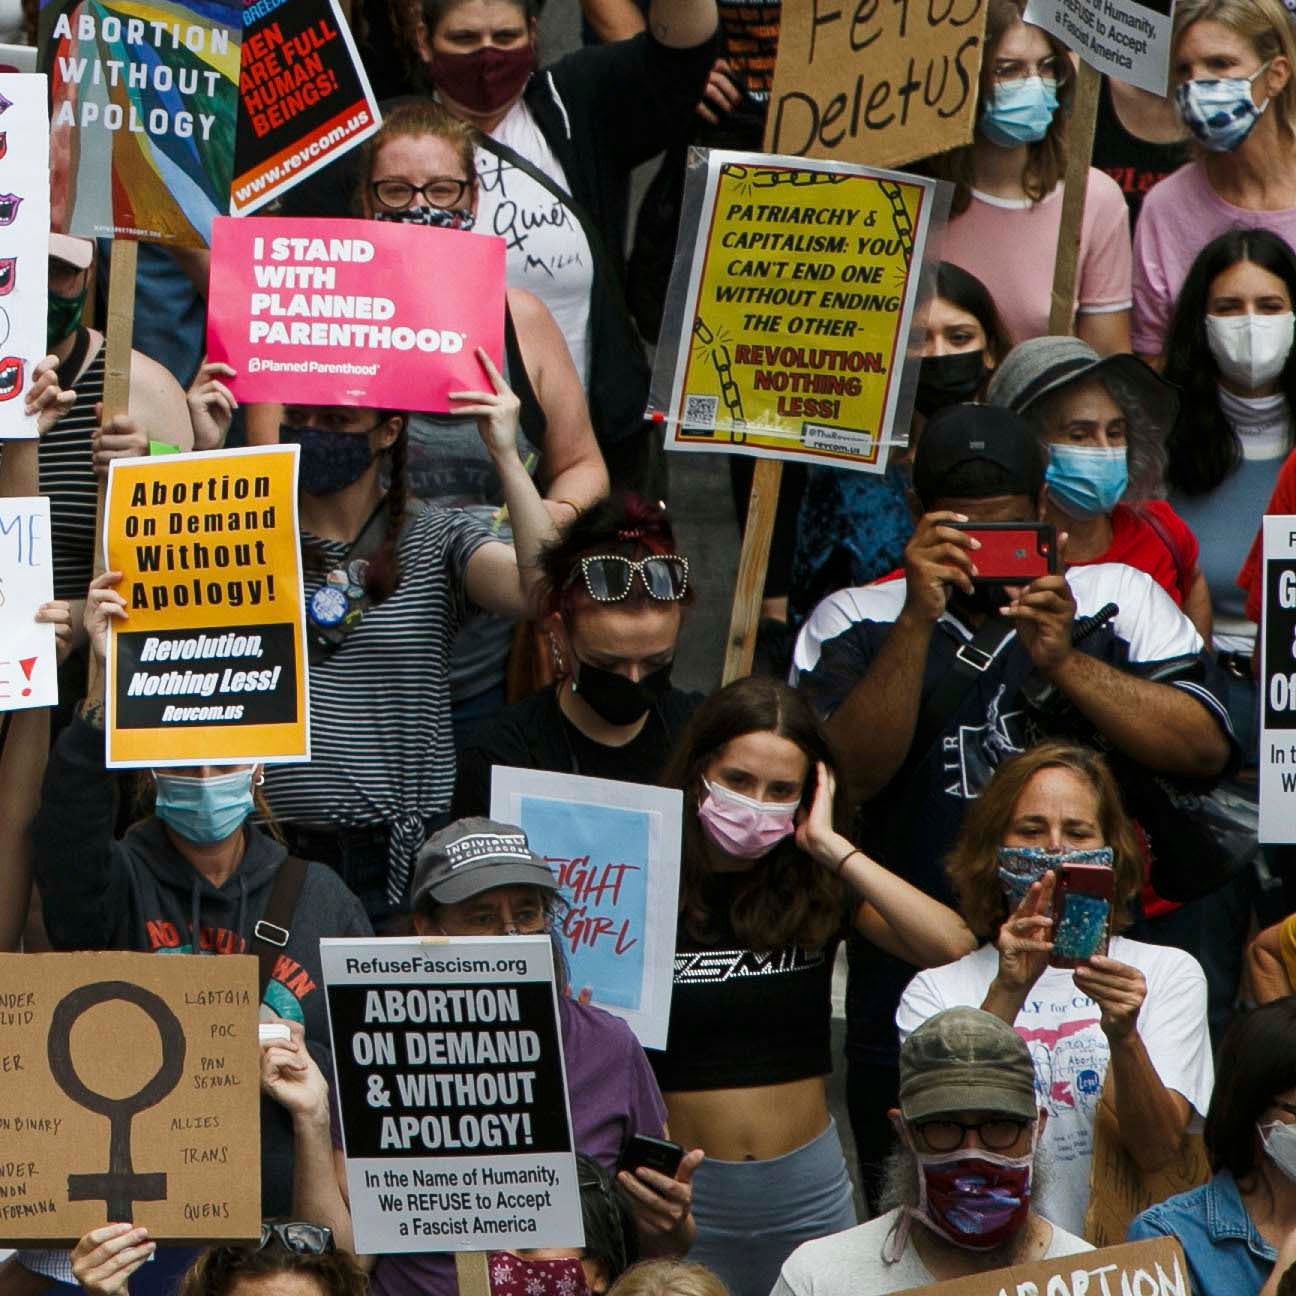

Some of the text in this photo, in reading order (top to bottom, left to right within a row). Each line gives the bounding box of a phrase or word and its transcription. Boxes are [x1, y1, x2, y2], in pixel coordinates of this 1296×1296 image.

[53, 12, 229, 55] ABORTION
[58, 56, 221, 97] WITHOUT
[57, 100, 217, 141] APOLOGY
[234, 110, 369, 203] www.revcom.us
[725, 204, 878, 227] PATRIARCHY &
[254, 237, 375, 263] I STAND
[721, 231, 902, 257] CAPITALISM: YOU
[253, 265, 336, 289] WITH
[726, 260, 886, 284] CAN'T END ONE
[251, 293, 396, 321] PLANNED
[715, 285, 900, 312] WITHOUT ENDING
[743, 313, 782, 333] THE
[249, 320, 463, 354] PARENTHOOD
[261, 359, 378, 376] Planned Parenthood
[753, 370, 863, 396] NOTHING
[776, 396, 840, 421] LESS!
[131, 475, 271, 507] Abortion
[125, 506, 276, 538] On Demand
[136, 540, 267, 572] Without
[131, 574, 276, 611] Apology!
[162, 704, 245, 722] Revcom.us
[346, 956, 528, 975] RefuseFascism.org
[364, 988, 521, 1024] ABORTION
[352, 1030, 542, 1066] ON DEMAND
[365, 1164, 560, 1188] In the Name of Humanity,
[0, 1183, 28, 1197] NON
[378, 1190, 552, 1213] We REFUSE to Accept
[399, 1216, 537, 1236] a Fascist America
